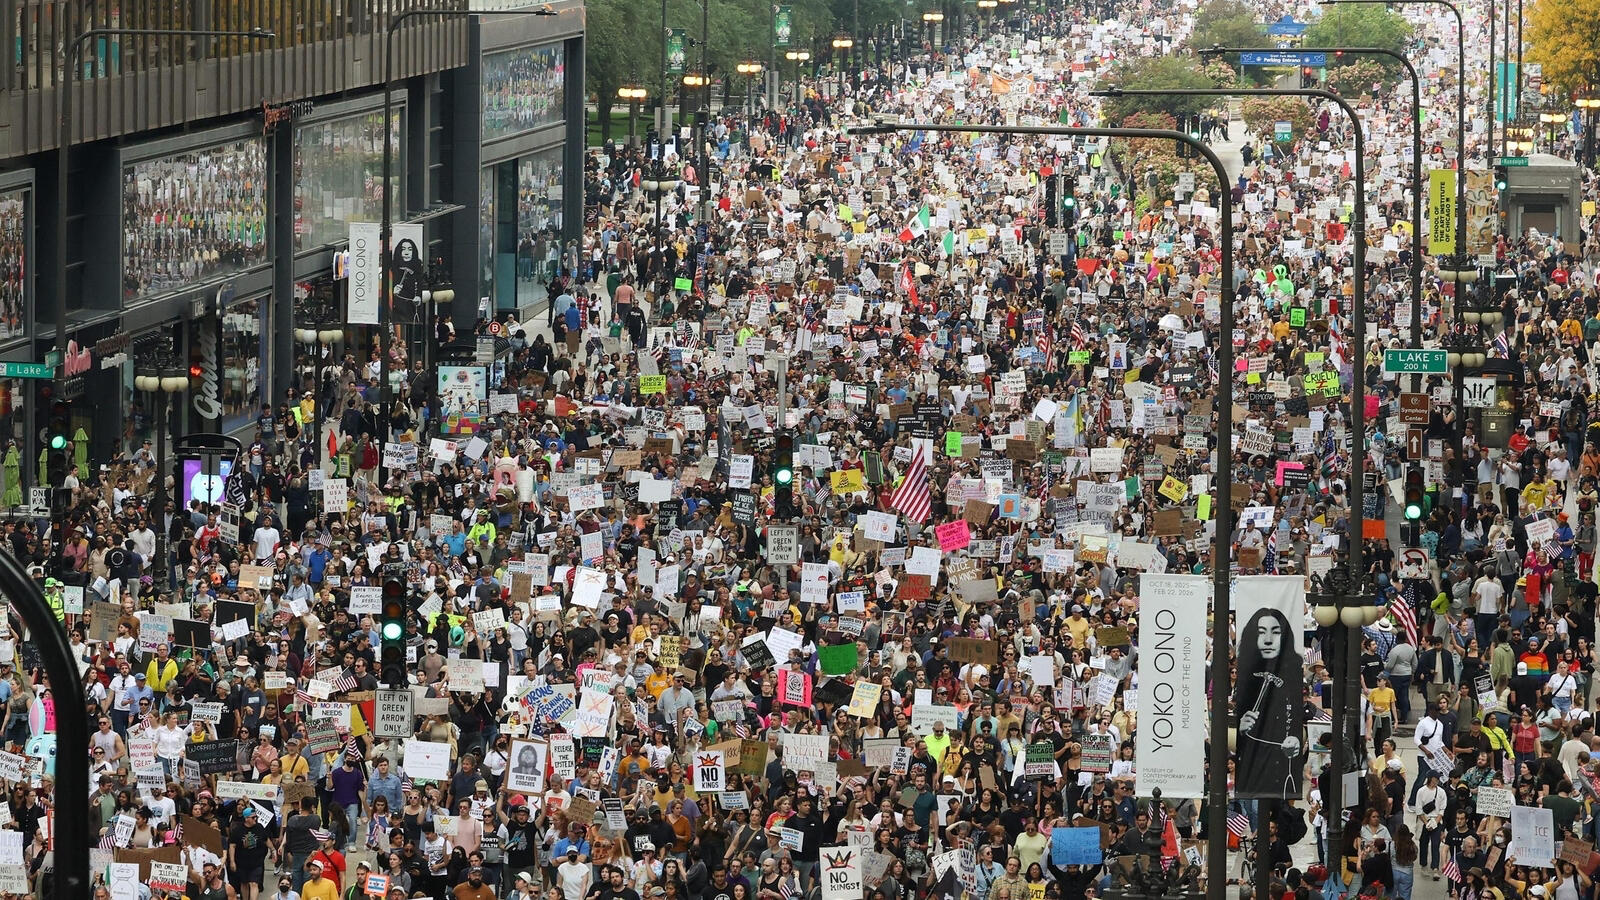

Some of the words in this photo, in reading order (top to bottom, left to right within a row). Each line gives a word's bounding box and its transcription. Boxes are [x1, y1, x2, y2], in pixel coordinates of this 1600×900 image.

[1434, 207, 1439, 216] OF
[356, 238, 366, 268] ONO
[355, 271, 366, 304] YOKO
[1398, 353, 1430, 362] LAKE
[17, 365, 41, 375] Lake
[1305, 371, 1338, 384] CRUELTY
[1246, 431, 1255, 440] NO
[1256, 433, 1275, 445] KINGS
[1244, 440, 1253, 448] NO
[1254, 442, 1272, 454] PEDOS
[773, 537, 792, 545] GREEN
[908, 575, 922, 584] NO
[802, 586, 814, 594] SAME
[815, 587, 827, 596] HATE
[900, 587, 930, 598] KINGS
[764, 601, 775, 609] NO
[475, 611, 495, 621] MELT
[487, 618, 502, 629] ICE
[839, 626, 861, 634] CHICAGO
[1154, 609, 1176, 674] ONO
[1182, 636, 1191, 662] MIND
[1182, 664, 1191, 681] THE
[582, 674, 593, 688] NO
[594, 673, 611, 683] KINGS
[520, 685, 554, 708] MORONS
[1182, 685, 1191, 697] OF
[379, 693, 396, 702] LEFT
[398, 694, 409, 702] ON
[382, 704, 405, 712] GREEN
[545, 698, 574, 723] AMERICA
[192, 714, 218, 722] CHICAGO
[381, 714, 406, 722] ARROW
[590, 714, 608, 725] KINGS
[1152, 682, 1174, 753] YOKO
[1182, 700, 1191, 729] MUSIC
[384, 724, 402, 732] ONLY
[554, 745, 573, 753] RELEASE
[555, 761, 574, 769] EPSTEIN
[701, 767, 718, 782] NO
[702, 781, 719, 789] KINGS
[1535, 825, 1548, 837] ICE
[854, 835, 871, 846] NO
[934, 852, 954, 867] ICE
[159, 870, 180, 878] ILLEGAL
[830, 871, 848, 883] NO
[831, 882, 861, 891] KINGS!
